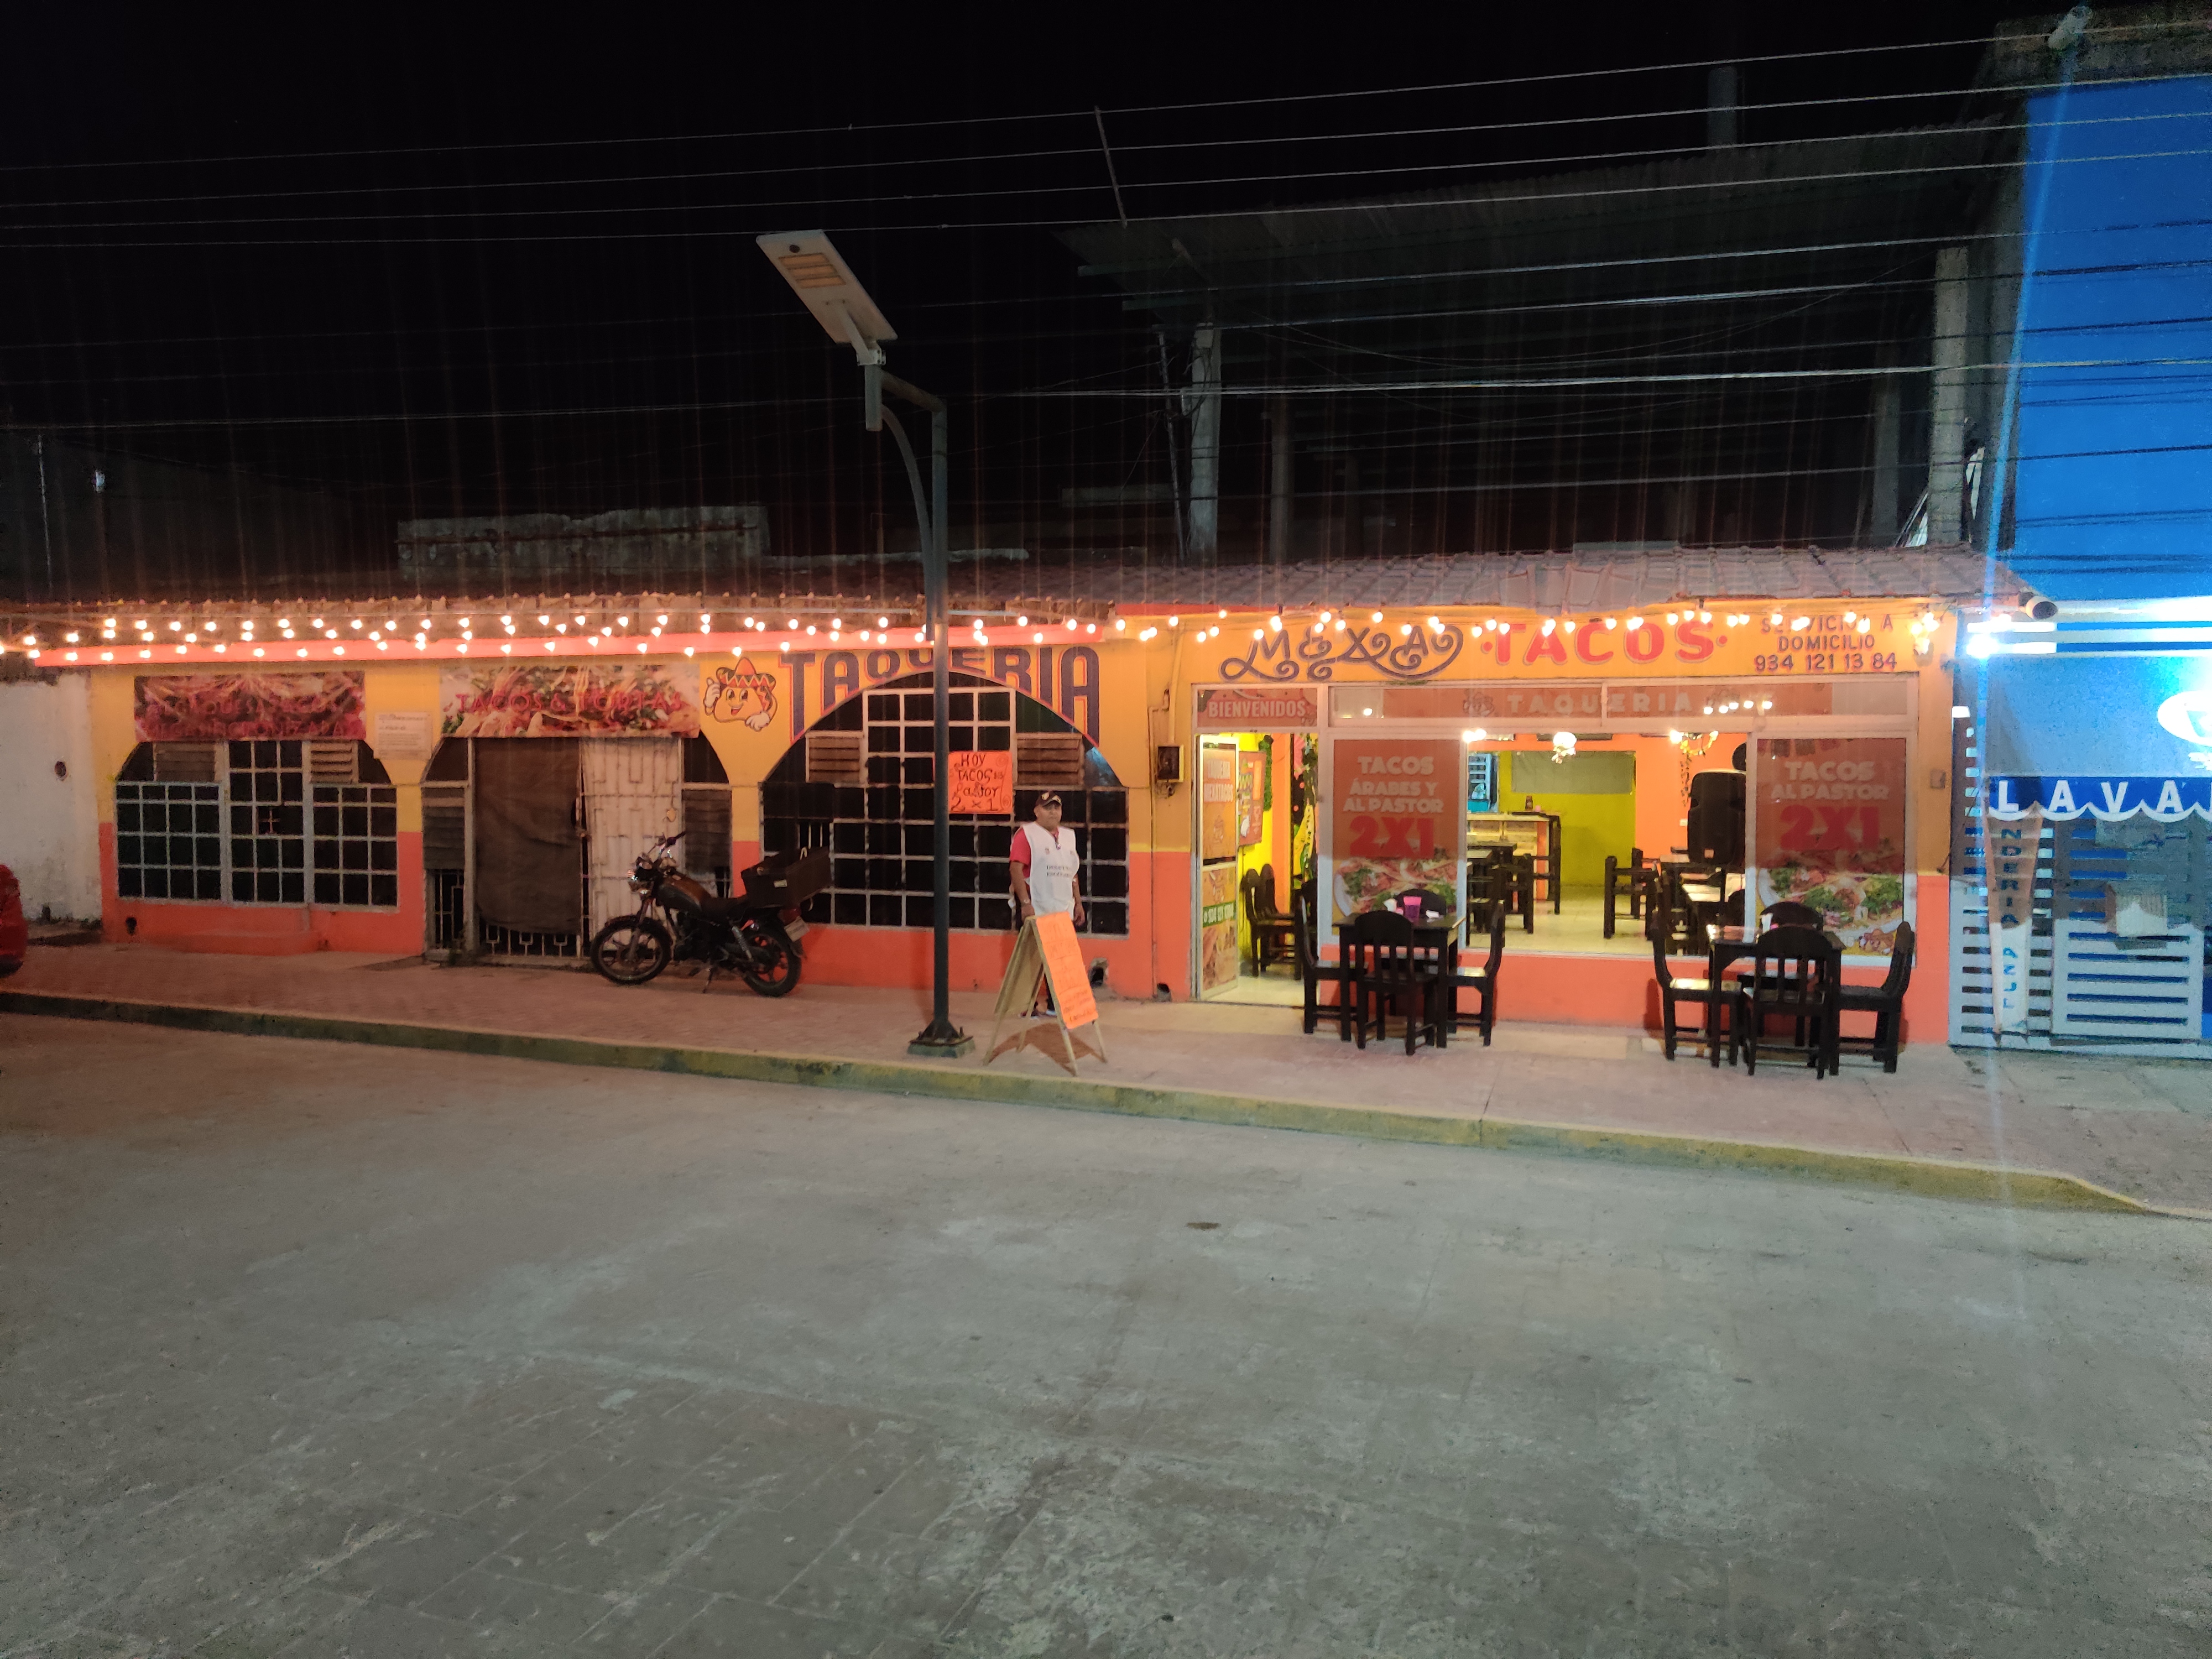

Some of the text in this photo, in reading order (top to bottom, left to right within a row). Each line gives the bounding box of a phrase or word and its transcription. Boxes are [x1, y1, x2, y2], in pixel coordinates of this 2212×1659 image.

[1881, 614, 1893, 632] A
[1494, 620, 1714, 665] TACOS
[1778, 635, 1875, 651] DOMICILIO
[1755, 652, 1897, 671] 934 121 13 84
[456, 693, 542, 712] TACOS
[578, 691, 684, 712] TORTAS
[779, 646, 1100, 747] TAQUERIA
[1507, 693, 1692, 714] TAQUERIA
[1209, 701, 1306, 717] BIENVENIDOS
[961, 754, 986, 768] HOY
[1358, 756, 1434, 775] TACOS
[958, 769, 993, 784] TACOS
[1785, 761, 1875, 781] TACOS
[1349, 778, 1438, 796] ÁRABES Y
[1771, 784, 1890, 800] AL PASTOR
[1999, 779, 2212, 813] LAVA
[951, 797, 966, 811] 2
[987, 798, 998, 811] 1
[1343, 797, 1444, 813] AL PASTOR
